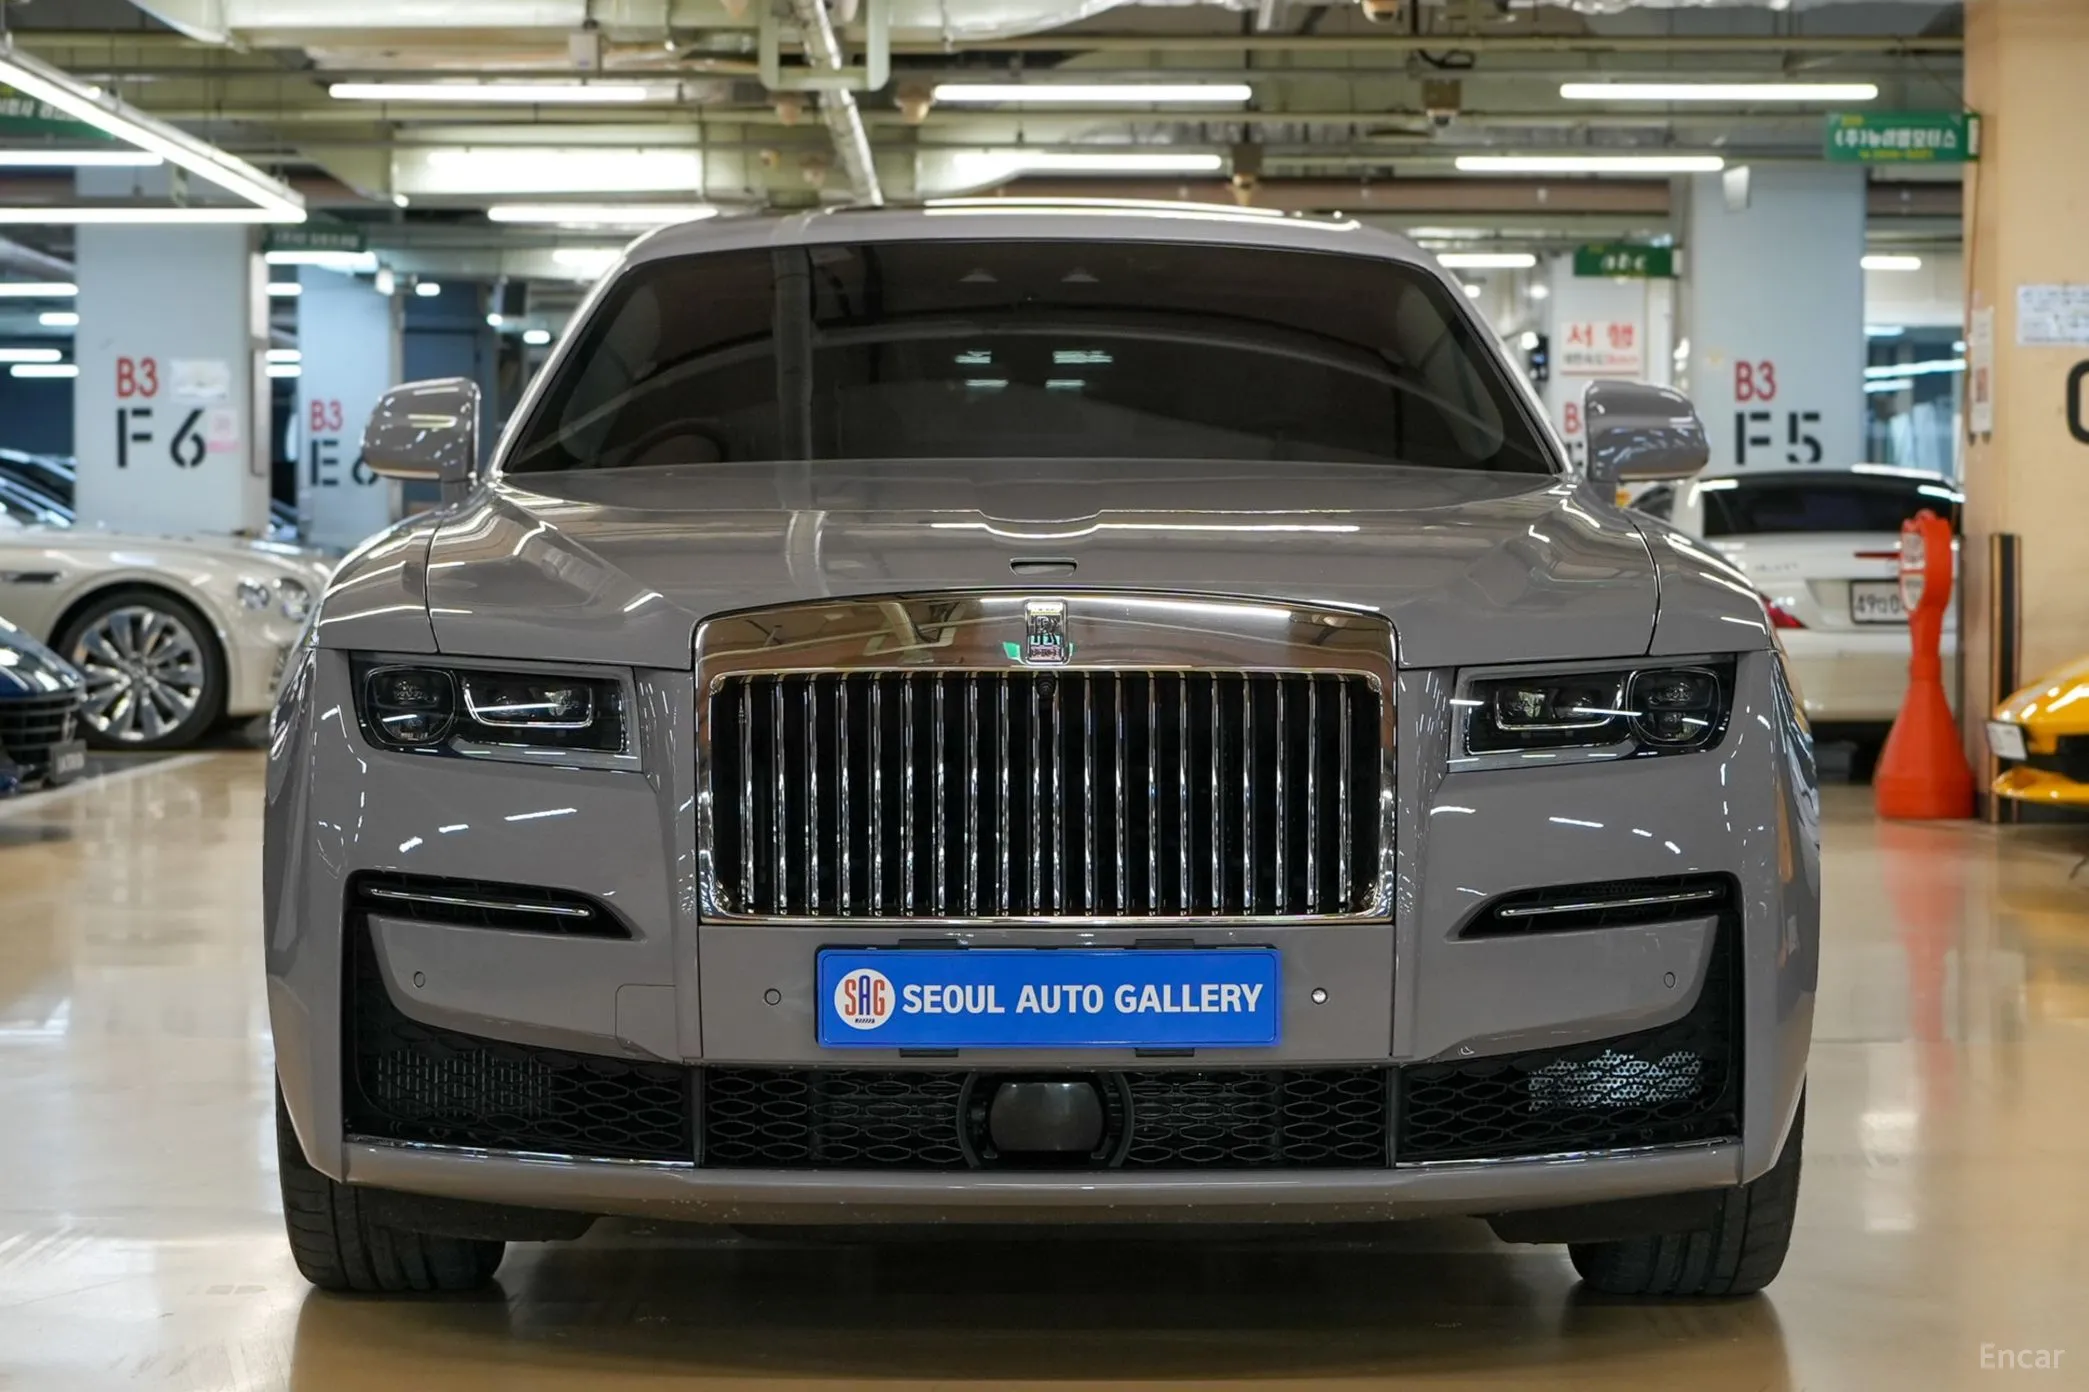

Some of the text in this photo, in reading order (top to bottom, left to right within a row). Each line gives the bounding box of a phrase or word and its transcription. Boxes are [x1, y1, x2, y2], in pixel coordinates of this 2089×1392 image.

[117, 357, 158, 399] B3
[1736, 360, 1776, 402] B3
[310, 399, 343, 433] B3
[844, 975, 885, 1016] SAG
[902, 983, 1263, 1014] SEOUL AUTO GALLERY
